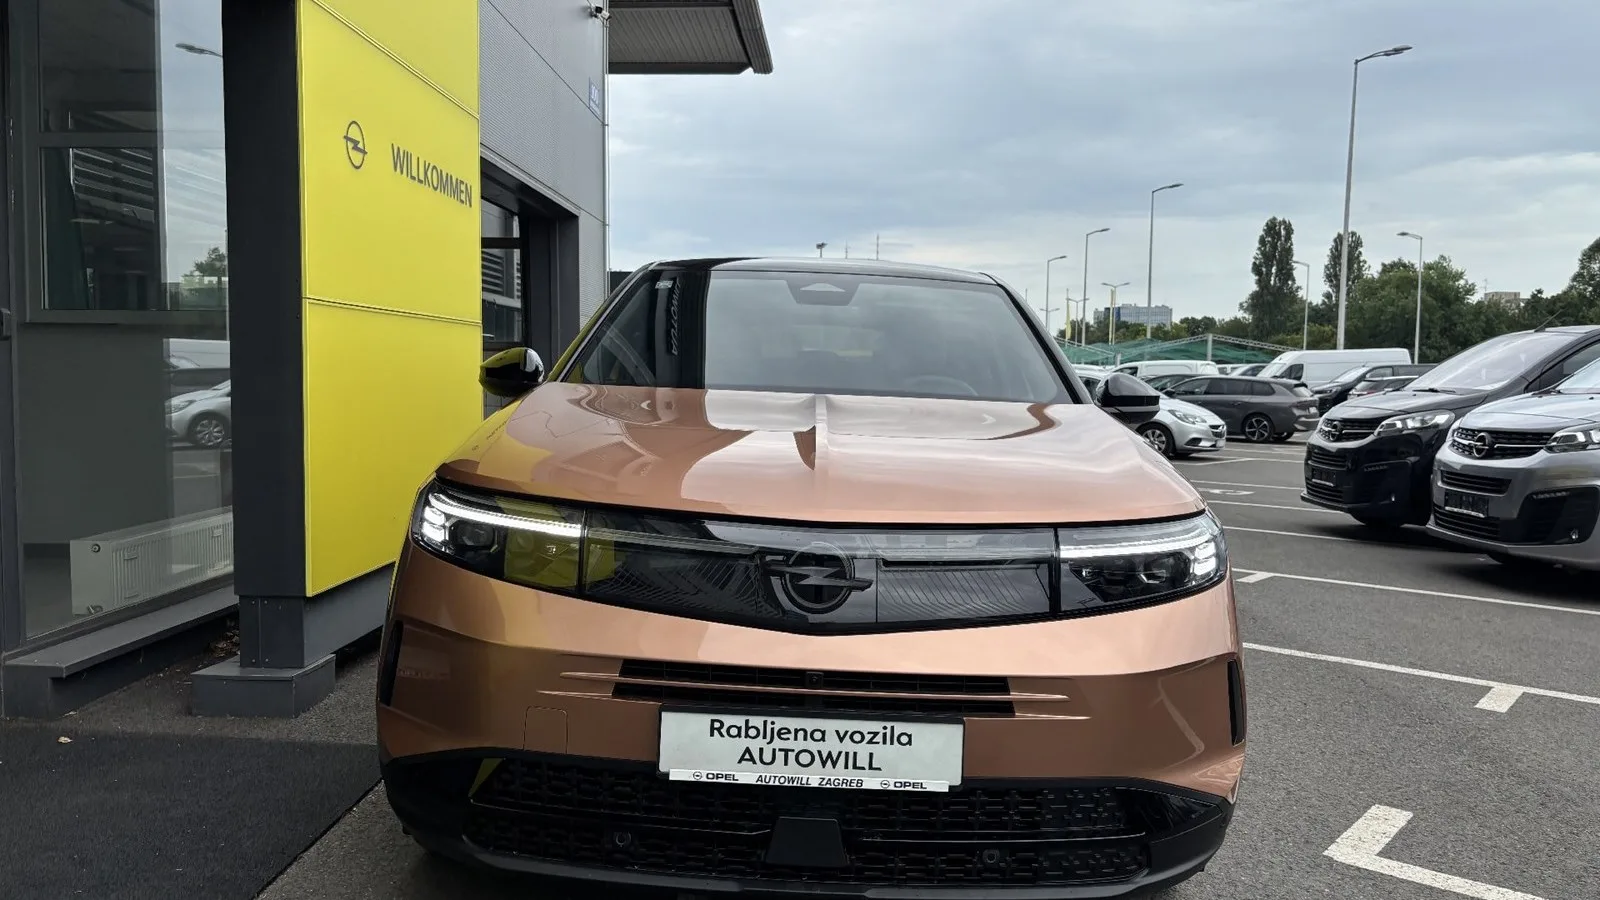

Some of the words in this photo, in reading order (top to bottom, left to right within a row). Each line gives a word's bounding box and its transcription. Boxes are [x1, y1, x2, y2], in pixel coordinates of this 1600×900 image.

[391, 142, 472, 208] WILLKOMMEN
[709, 718, 826, 745] Rabljena
[835, 725, 913, 747] vozila
[737, 746, 882, 771] AUTOWILL
[705, 773, 739, 782] OPEL
[755, 774, 812, 786] AUTOWILL
[818, 777, 864, 788] ZAGREB
[893, 781, 928, 790] OPEL
